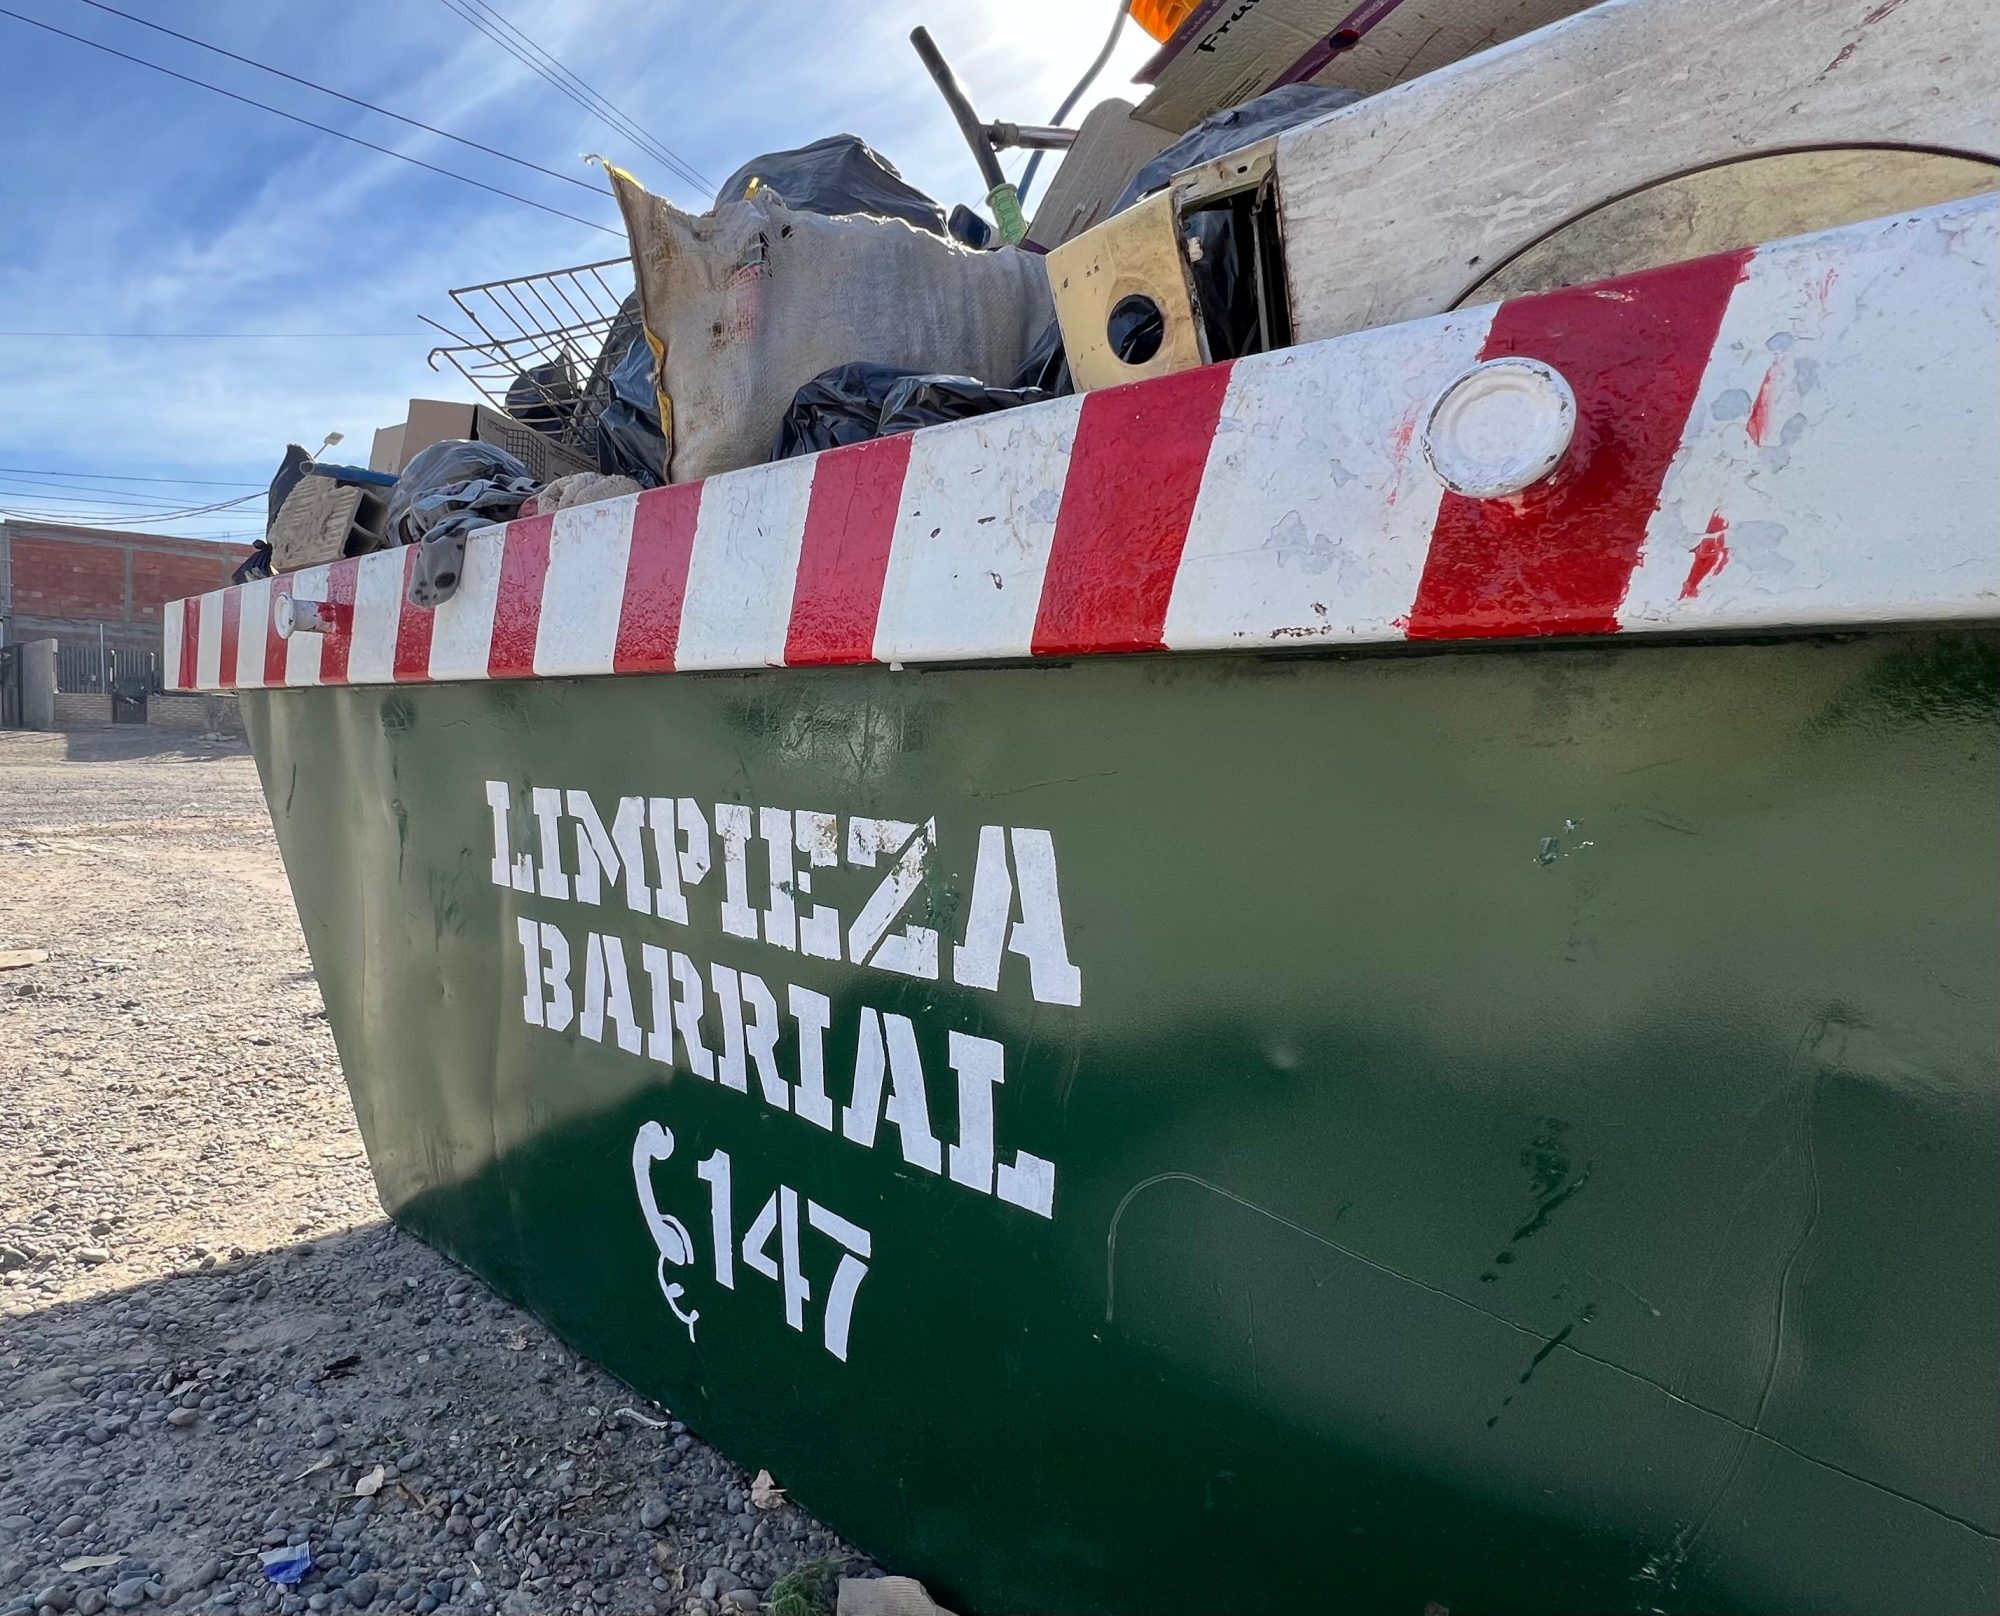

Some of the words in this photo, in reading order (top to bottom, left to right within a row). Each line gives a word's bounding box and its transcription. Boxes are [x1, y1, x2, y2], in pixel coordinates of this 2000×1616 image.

[1193, 0, 1260, 54] Fru
[485, 780, 1081, 1006] LIMPIEZA
[517, 916, 1055, 1219] BARRIAL
[697, 1148, 871, 1362] 147
